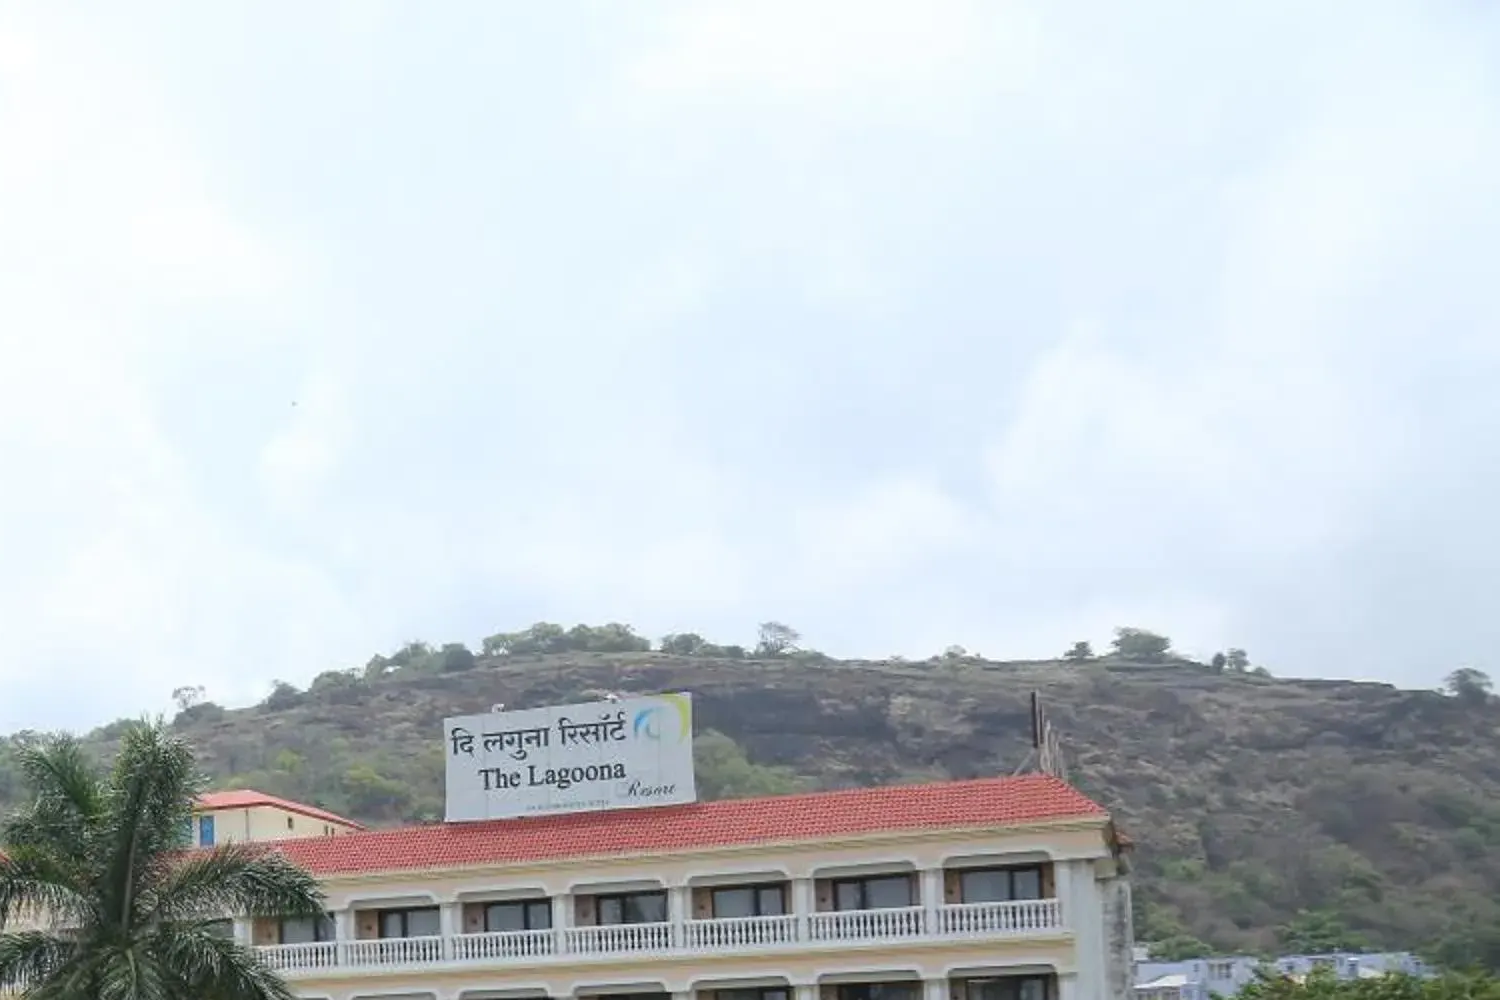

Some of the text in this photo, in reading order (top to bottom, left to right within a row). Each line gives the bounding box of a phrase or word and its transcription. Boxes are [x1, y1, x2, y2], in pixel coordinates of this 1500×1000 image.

[452, 711, 626, 759] दि लगुना रिसॉर्ट
[478, 762, 627, 790] The Lagoona
[628, 779, 676, 797] Resort
